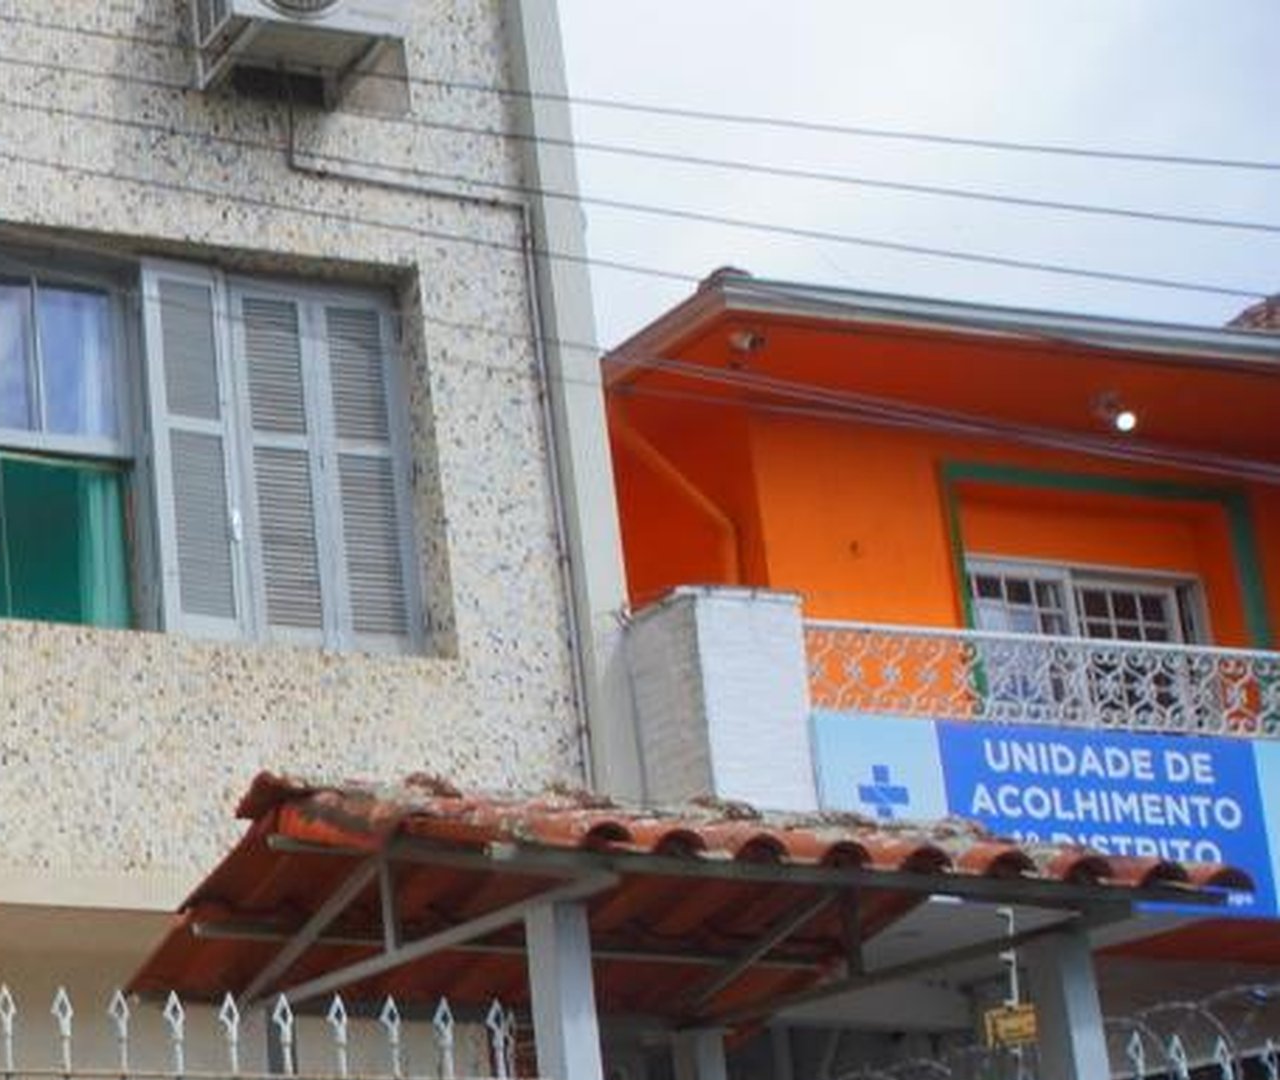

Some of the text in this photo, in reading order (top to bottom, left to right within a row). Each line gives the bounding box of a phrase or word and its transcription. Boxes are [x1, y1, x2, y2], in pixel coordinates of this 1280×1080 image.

[984, 739, 1216, 784] UNIDADE DE
[971, 783, 1242, 831] ACOLHIMENTO
